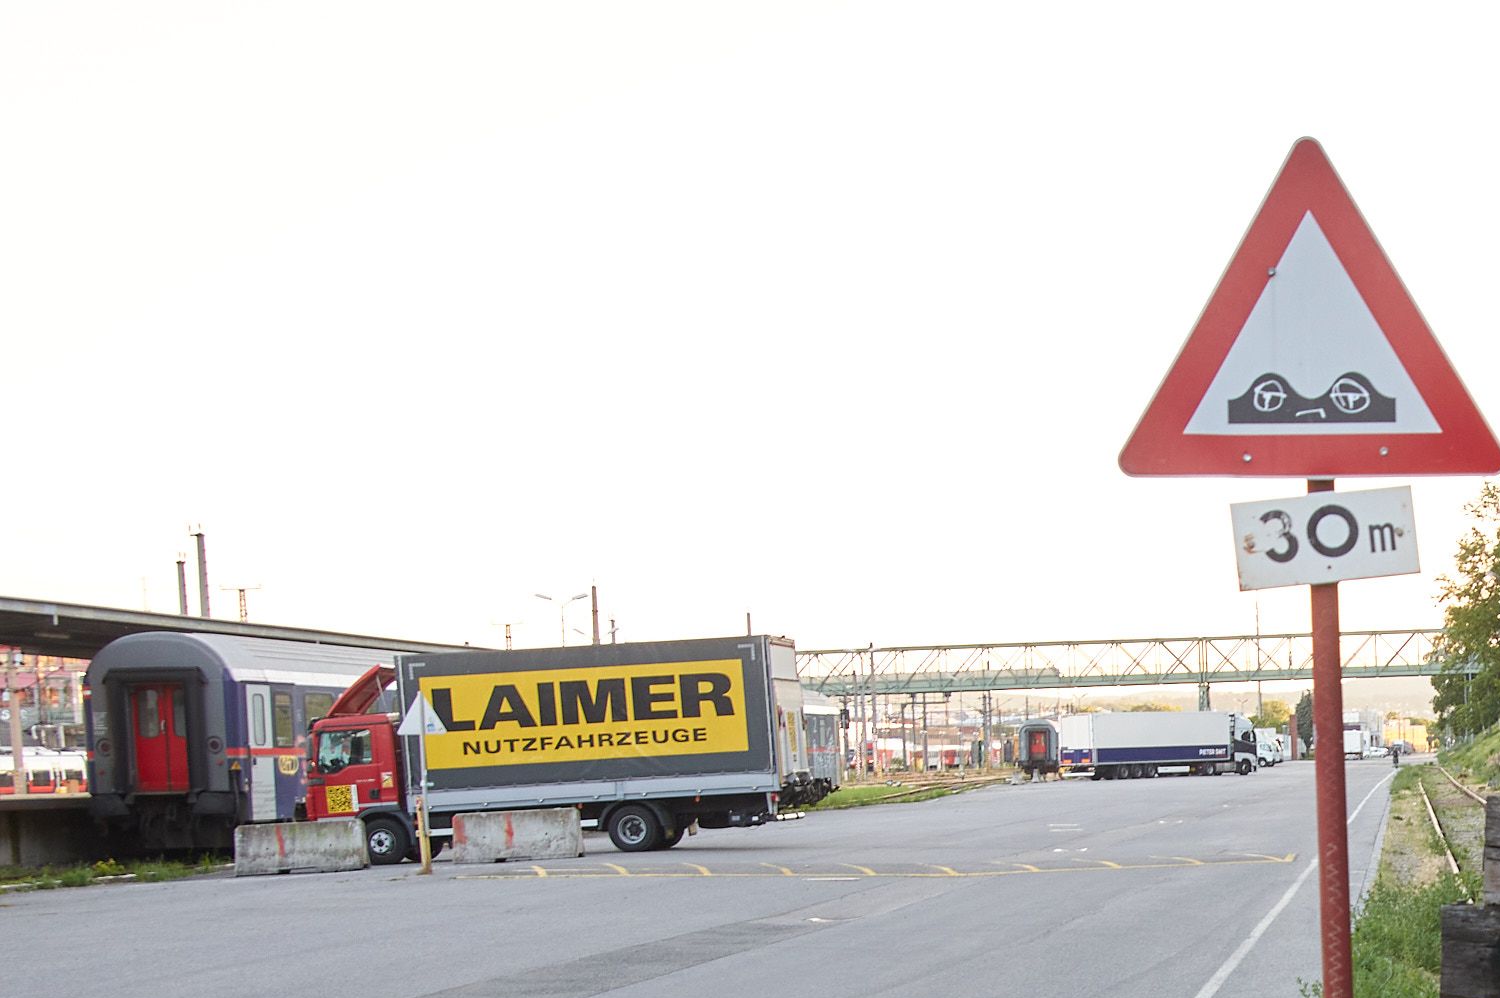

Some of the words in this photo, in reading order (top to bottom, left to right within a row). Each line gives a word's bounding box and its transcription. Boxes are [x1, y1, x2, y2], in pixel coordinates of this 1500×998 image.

[1259, 504, 1359, 563] 30
[1368, 522, 1397, 553] m
[431, 672, 735, 732] LAIMER
[463, 727, 708, 756] NUTZFAHRZEUGE
